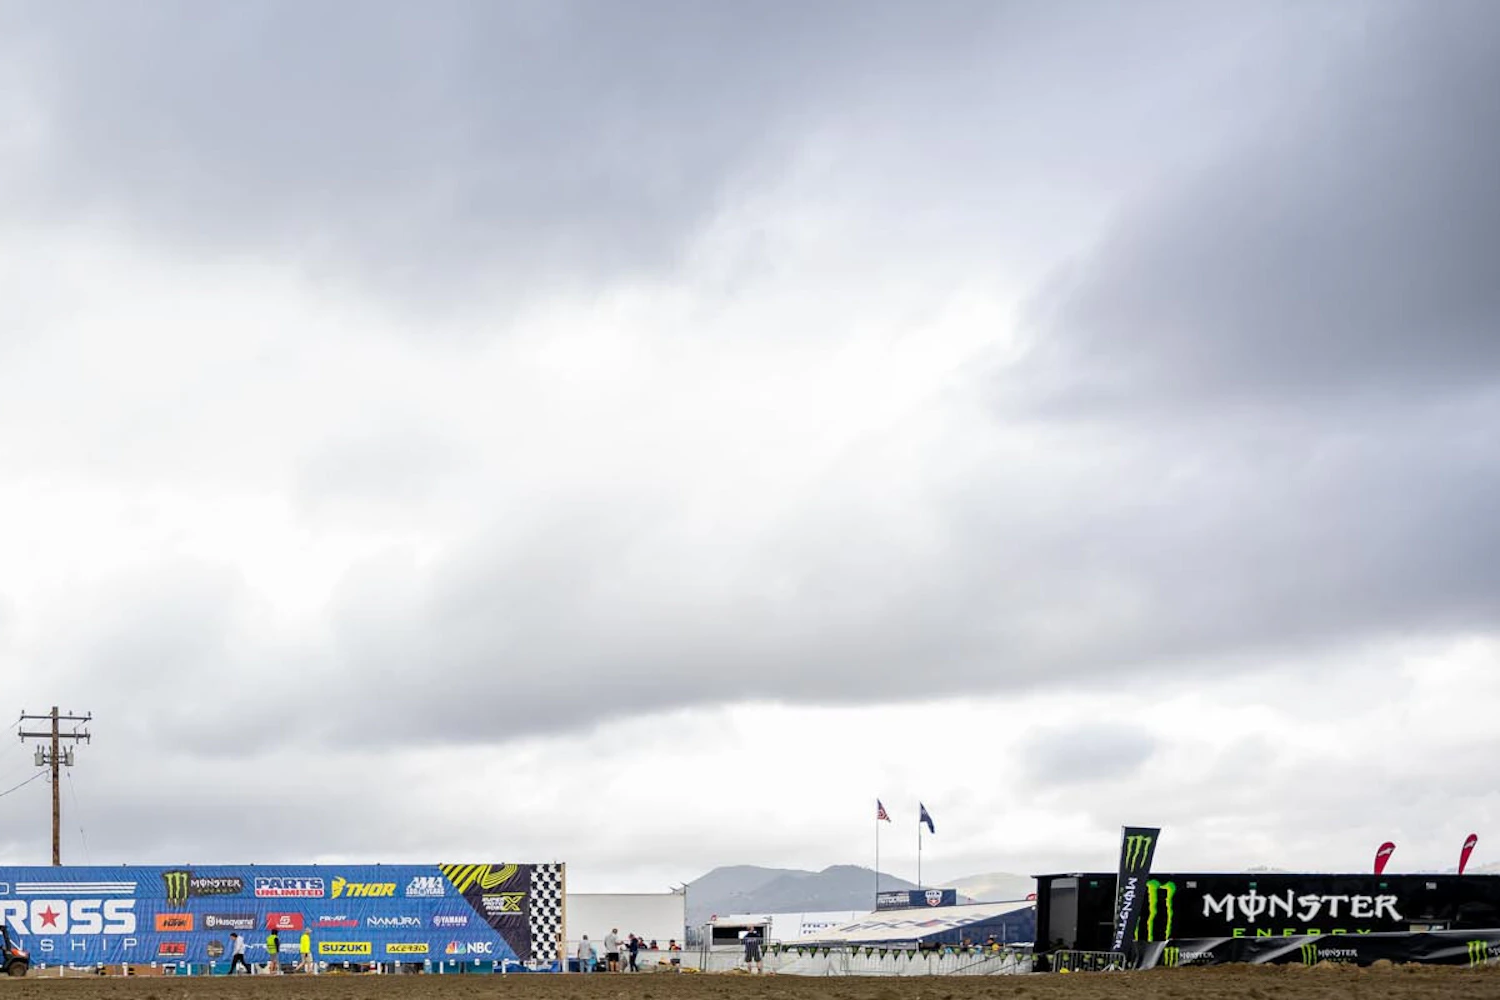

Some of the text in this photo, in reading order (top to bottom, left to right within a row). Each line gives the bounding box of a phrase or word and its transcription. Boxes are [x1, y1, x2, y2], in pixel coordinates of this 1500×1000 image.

[191, 879, 241, 888] MONSTER
[256, 878, 323, 889] PARTS
[408, 877, 443, 888] AMA
[346, 883, 396, 896] THOR
[1202, 890, 1403, 923] MONSTER
[1112, 877, 1138, 950] MONSTER
[367, 916, 420, 925] NAMURA
[322, 944, 367, 952] SUZUKI
[467, 942, 493, 954] NBC
